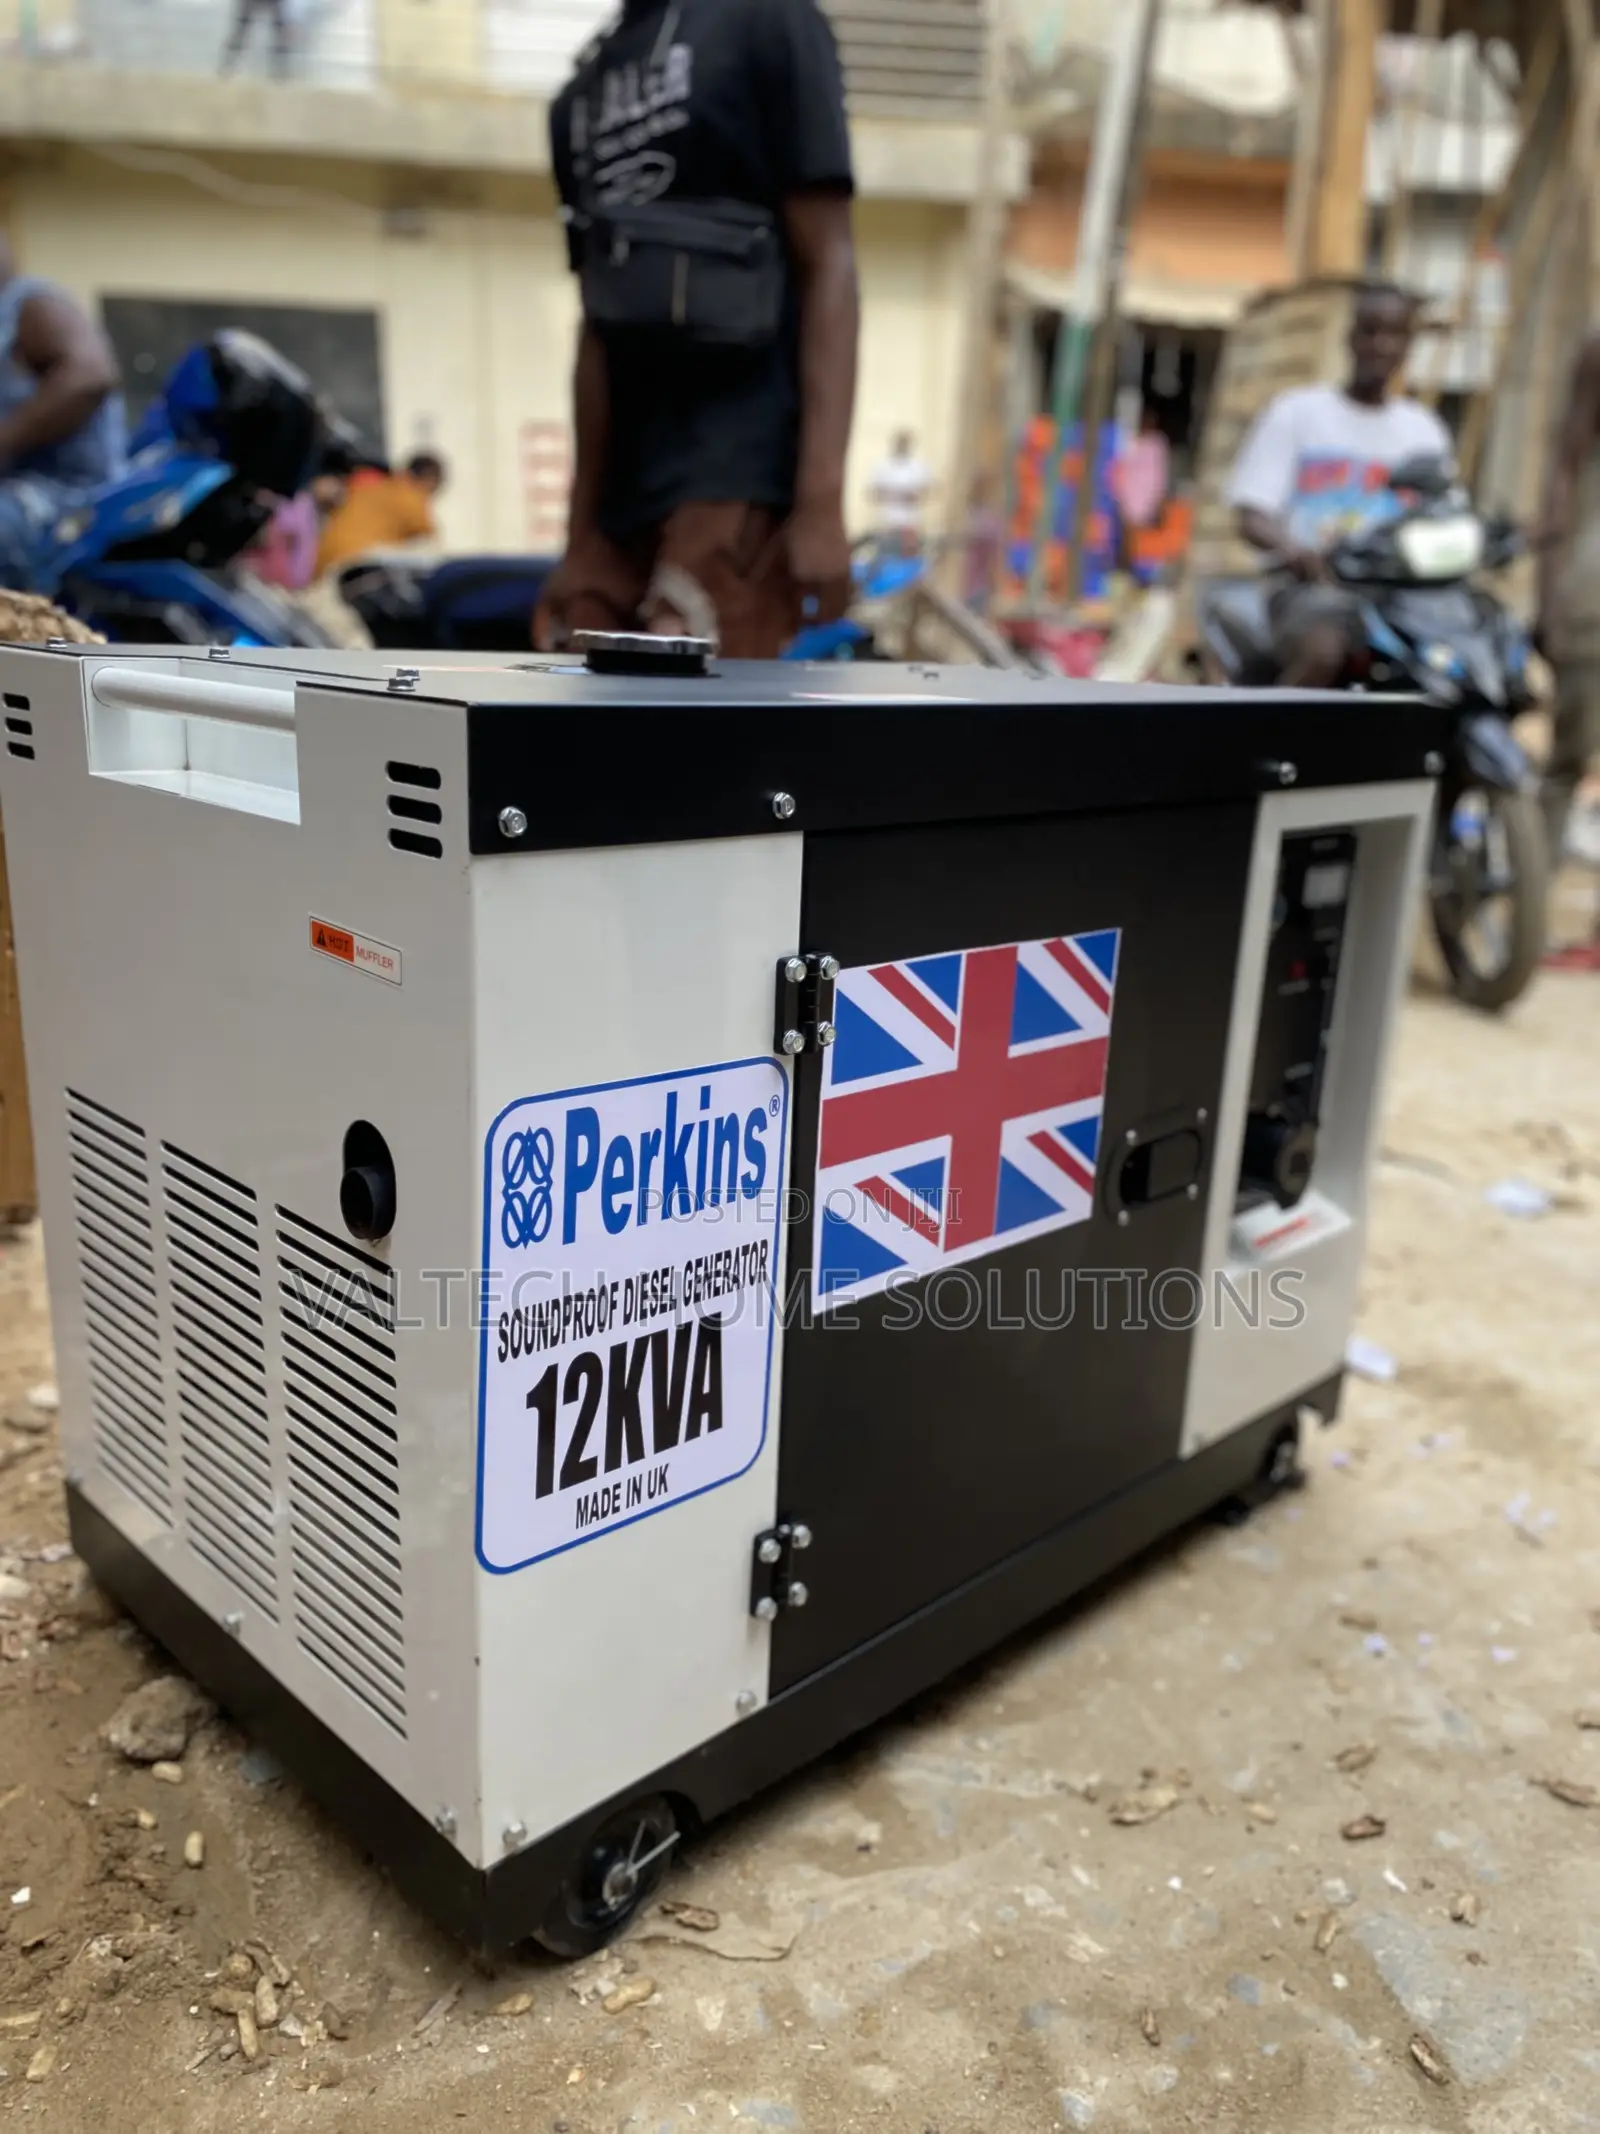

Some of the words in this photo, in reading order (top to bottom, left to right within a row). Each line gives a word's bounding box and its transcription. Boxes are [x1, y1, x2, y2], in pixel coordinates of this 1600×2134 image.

[328, 934, 349, 953] HOT
[355, 945, 394, 970] MUFFLER
[497, 1280, 618, 1364] SOUNDPROOF
[623, 1264, 678, 1325] DIESEL
[683, 1238, 769, 1307] GENERATOR
[526, 1311, 723, 1500] 12KVA
[575, 1487, 621, 1530] MADE
[625, 1477, 643, 1510] IN
[647, 1464, 669, 1498] UK
